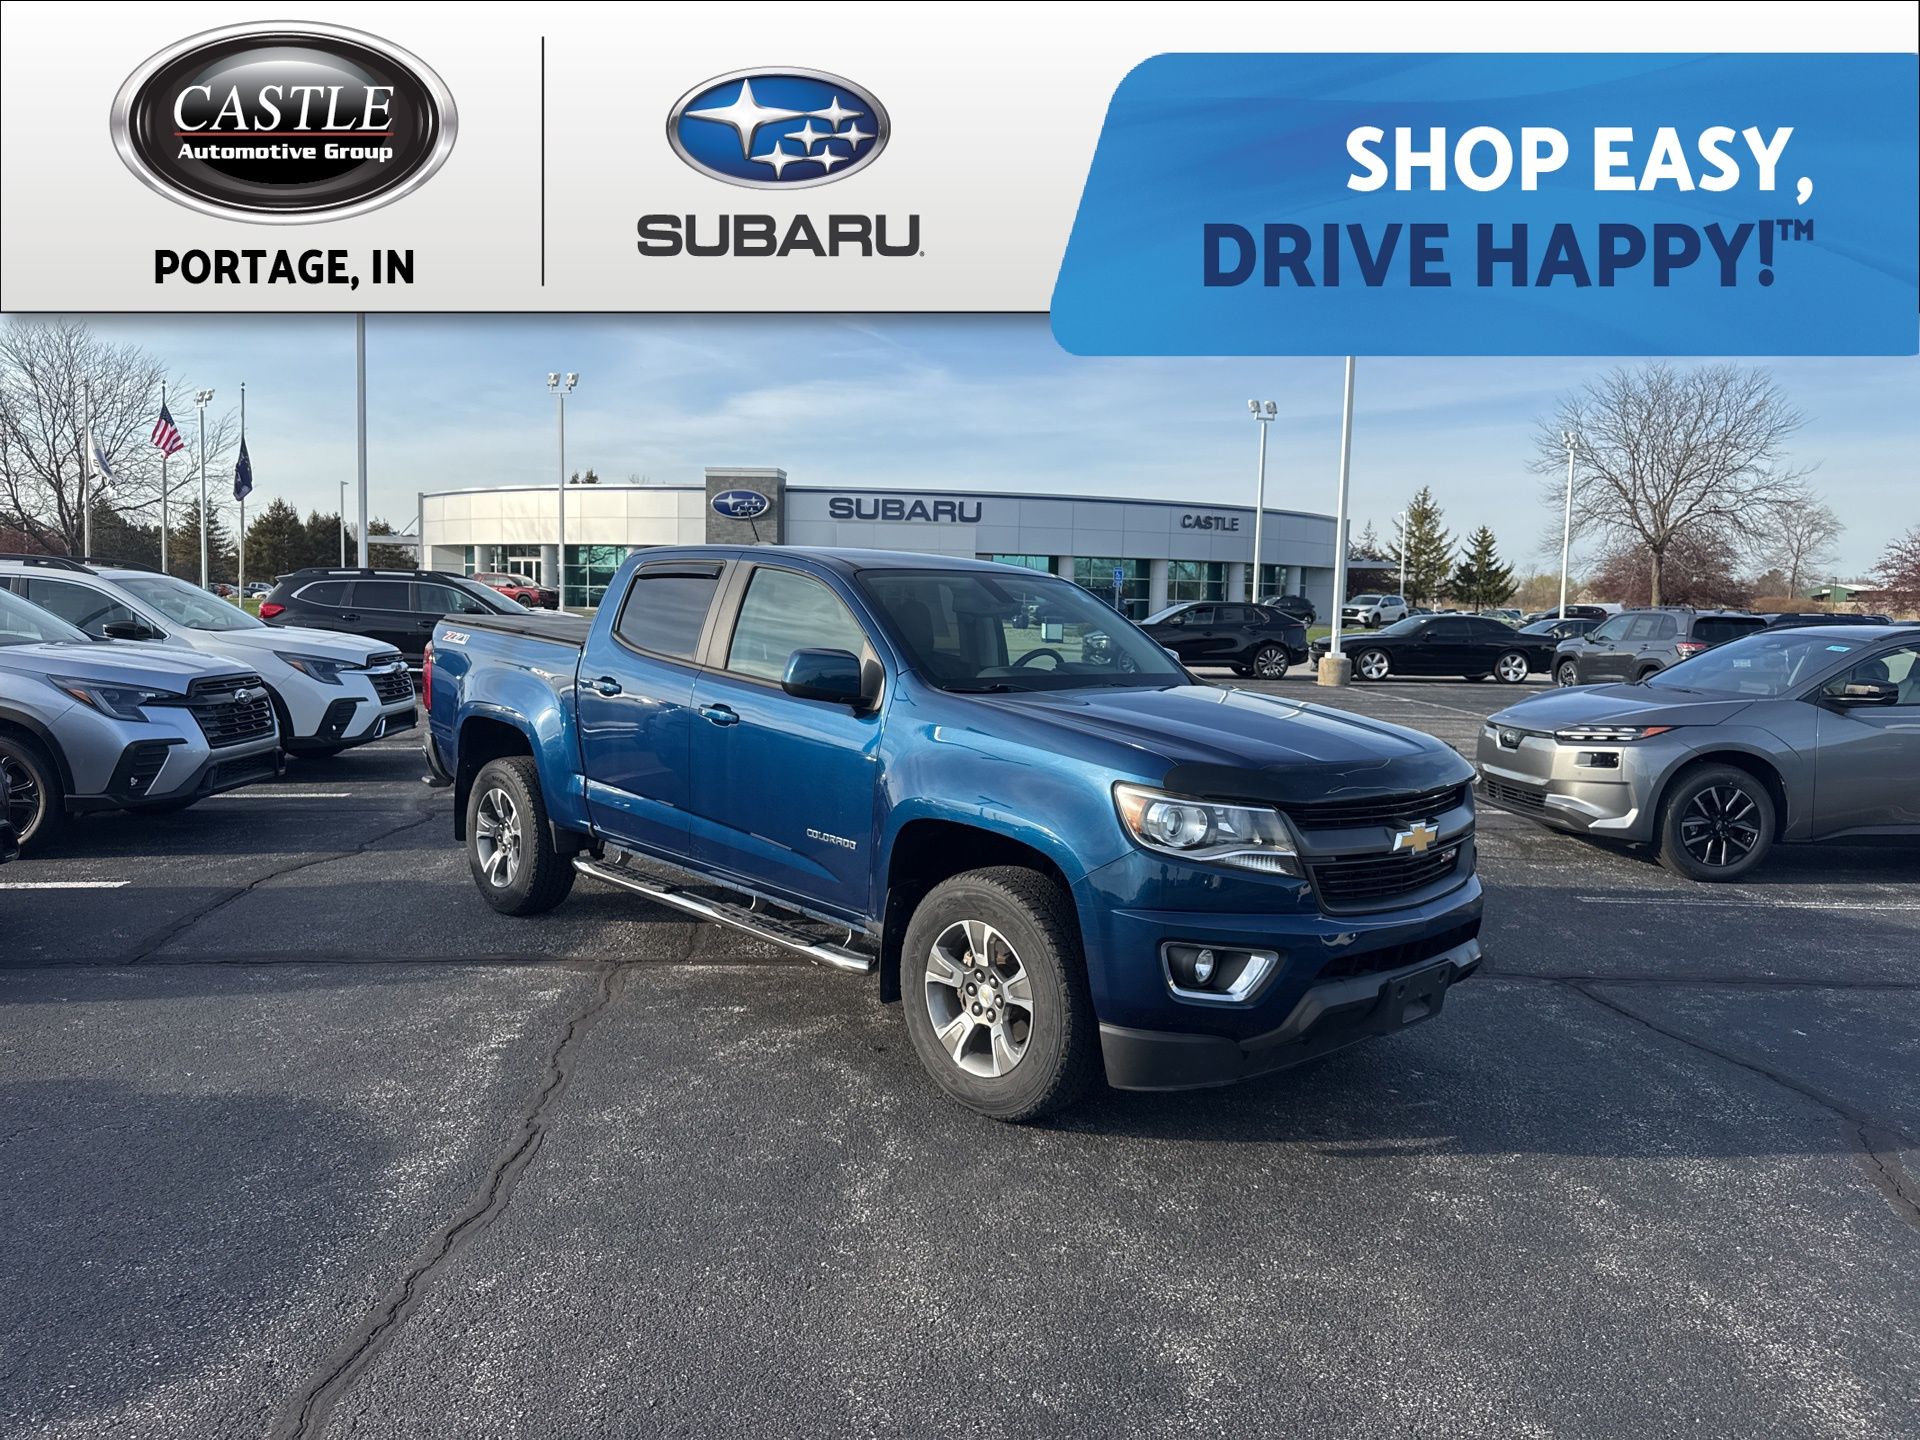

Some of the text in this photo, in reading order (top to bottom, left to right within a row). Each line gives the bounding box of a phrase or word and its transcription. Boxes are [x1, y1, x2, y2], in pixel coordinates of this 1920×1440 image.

[829, 497, 982, 523] SUBARU
[1181, 514, 1240, 532] CASTLE
[806, 828, 857, 850] COLORADO
